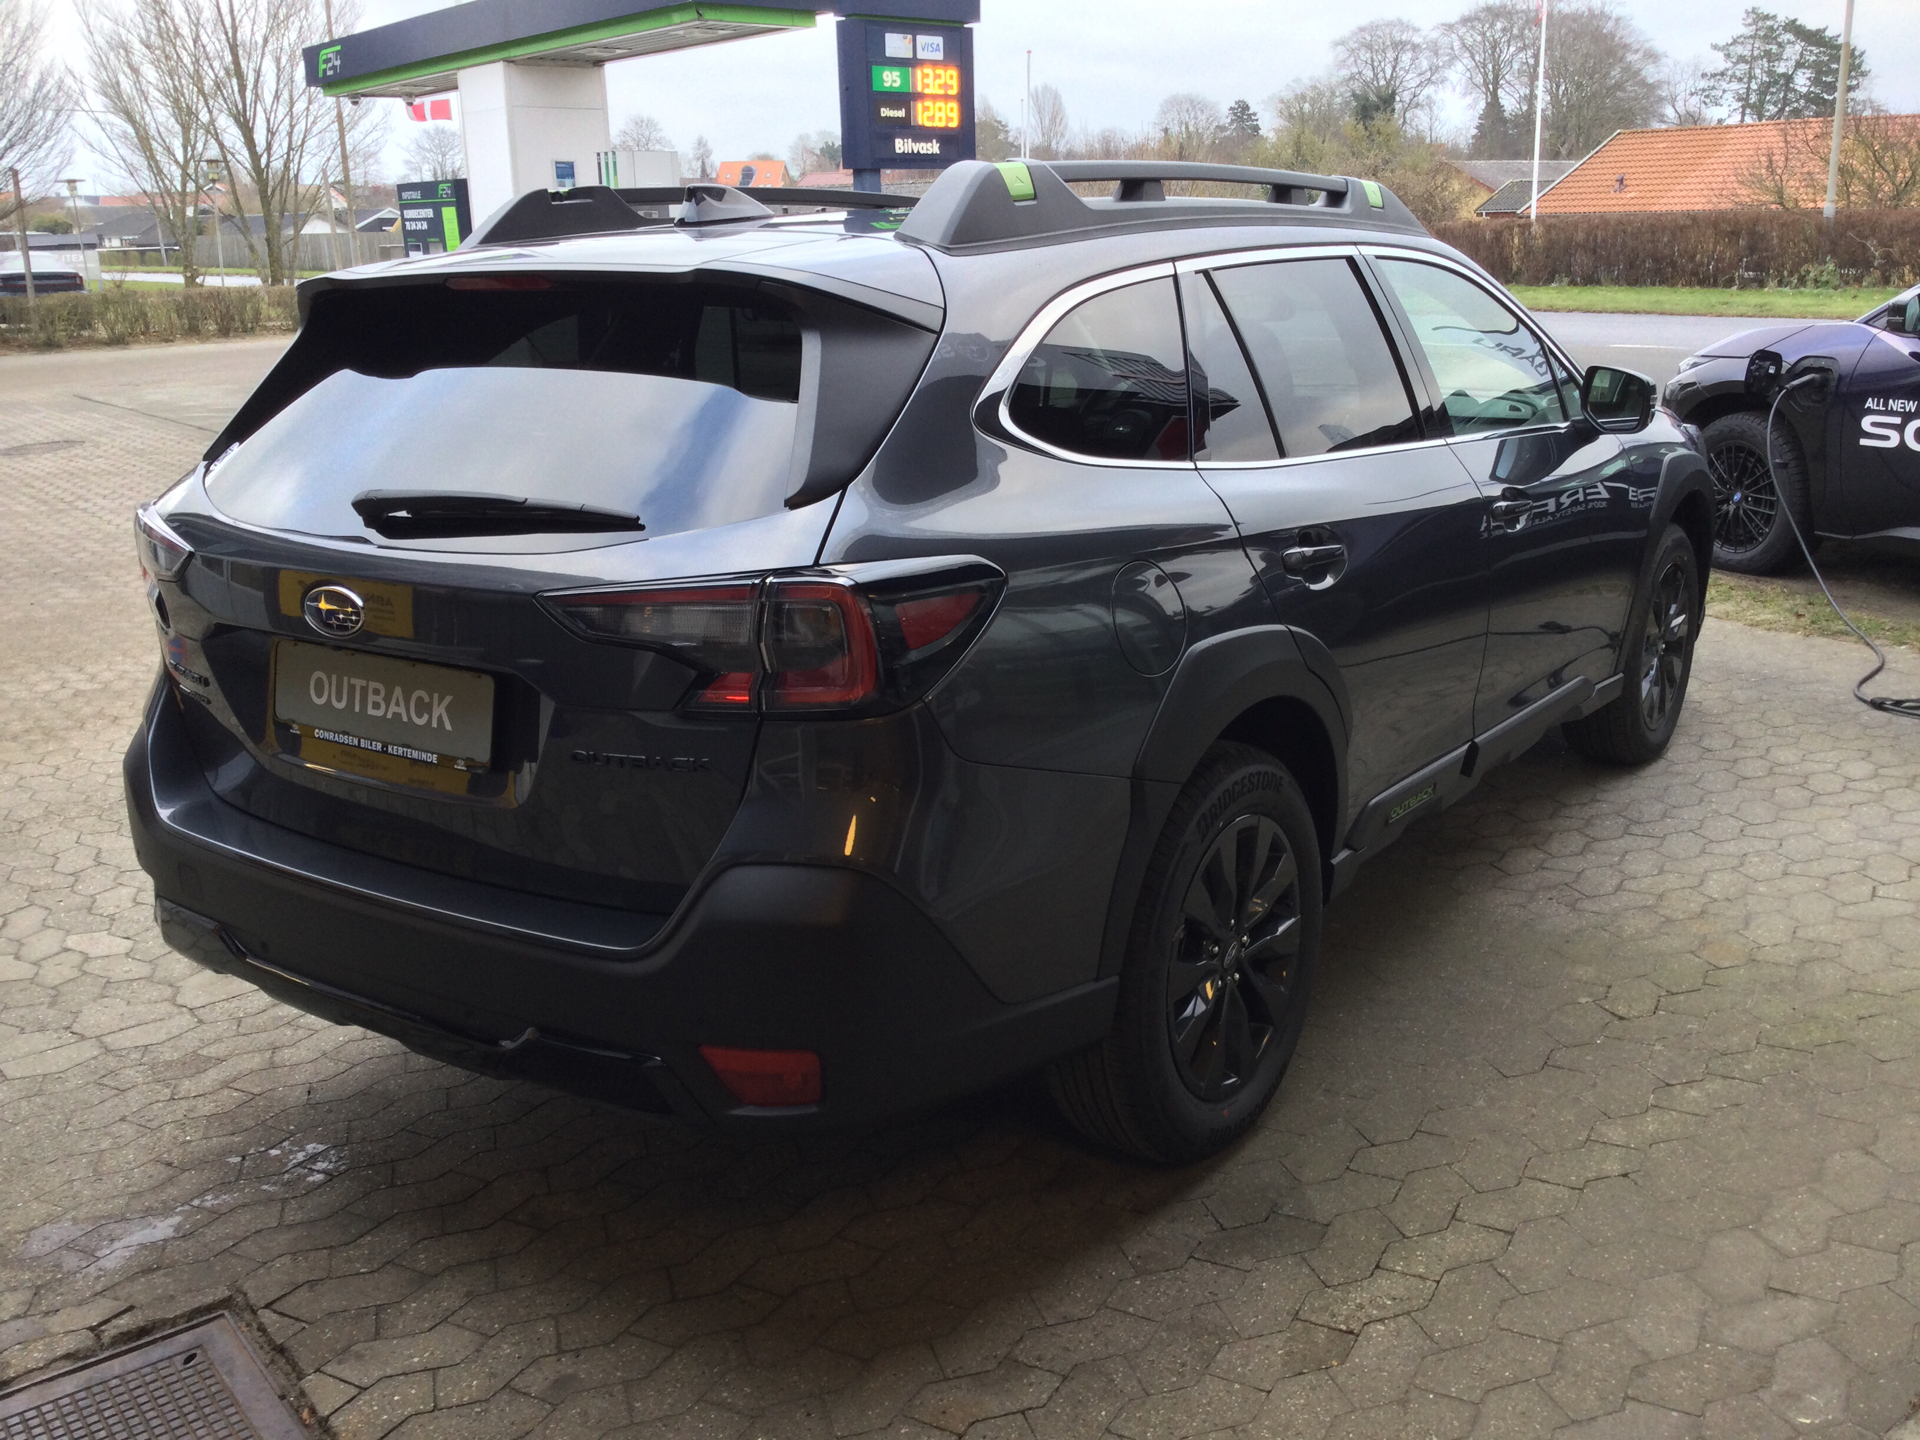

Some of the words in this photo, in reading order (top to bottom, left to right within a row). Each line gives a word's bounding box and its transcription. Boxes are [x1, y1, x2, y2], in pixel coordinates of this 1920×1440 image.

[920, 41, 941, 53] VISA
[318, 44, 341, 78] F24
[882, 70, 901, 87] 95
[880, 107, 906, 118] Diesel
[894, 138, 941, 154] Bilvask
[1864, 397, 1886, 411] ALL
[1888, 398, 1918, 413] NEW
[309, 670, 454, 731] OUTBACK
[314, 728, 359, 747] CONRADSEN
[360, 737, 382, 752] BILER
[387, 744, 438, 764] KERTEMINDE
[1195, 770, 1285, 843] BRIDGESTONE
[1391, 784, 1435, 818] OUTBACK
